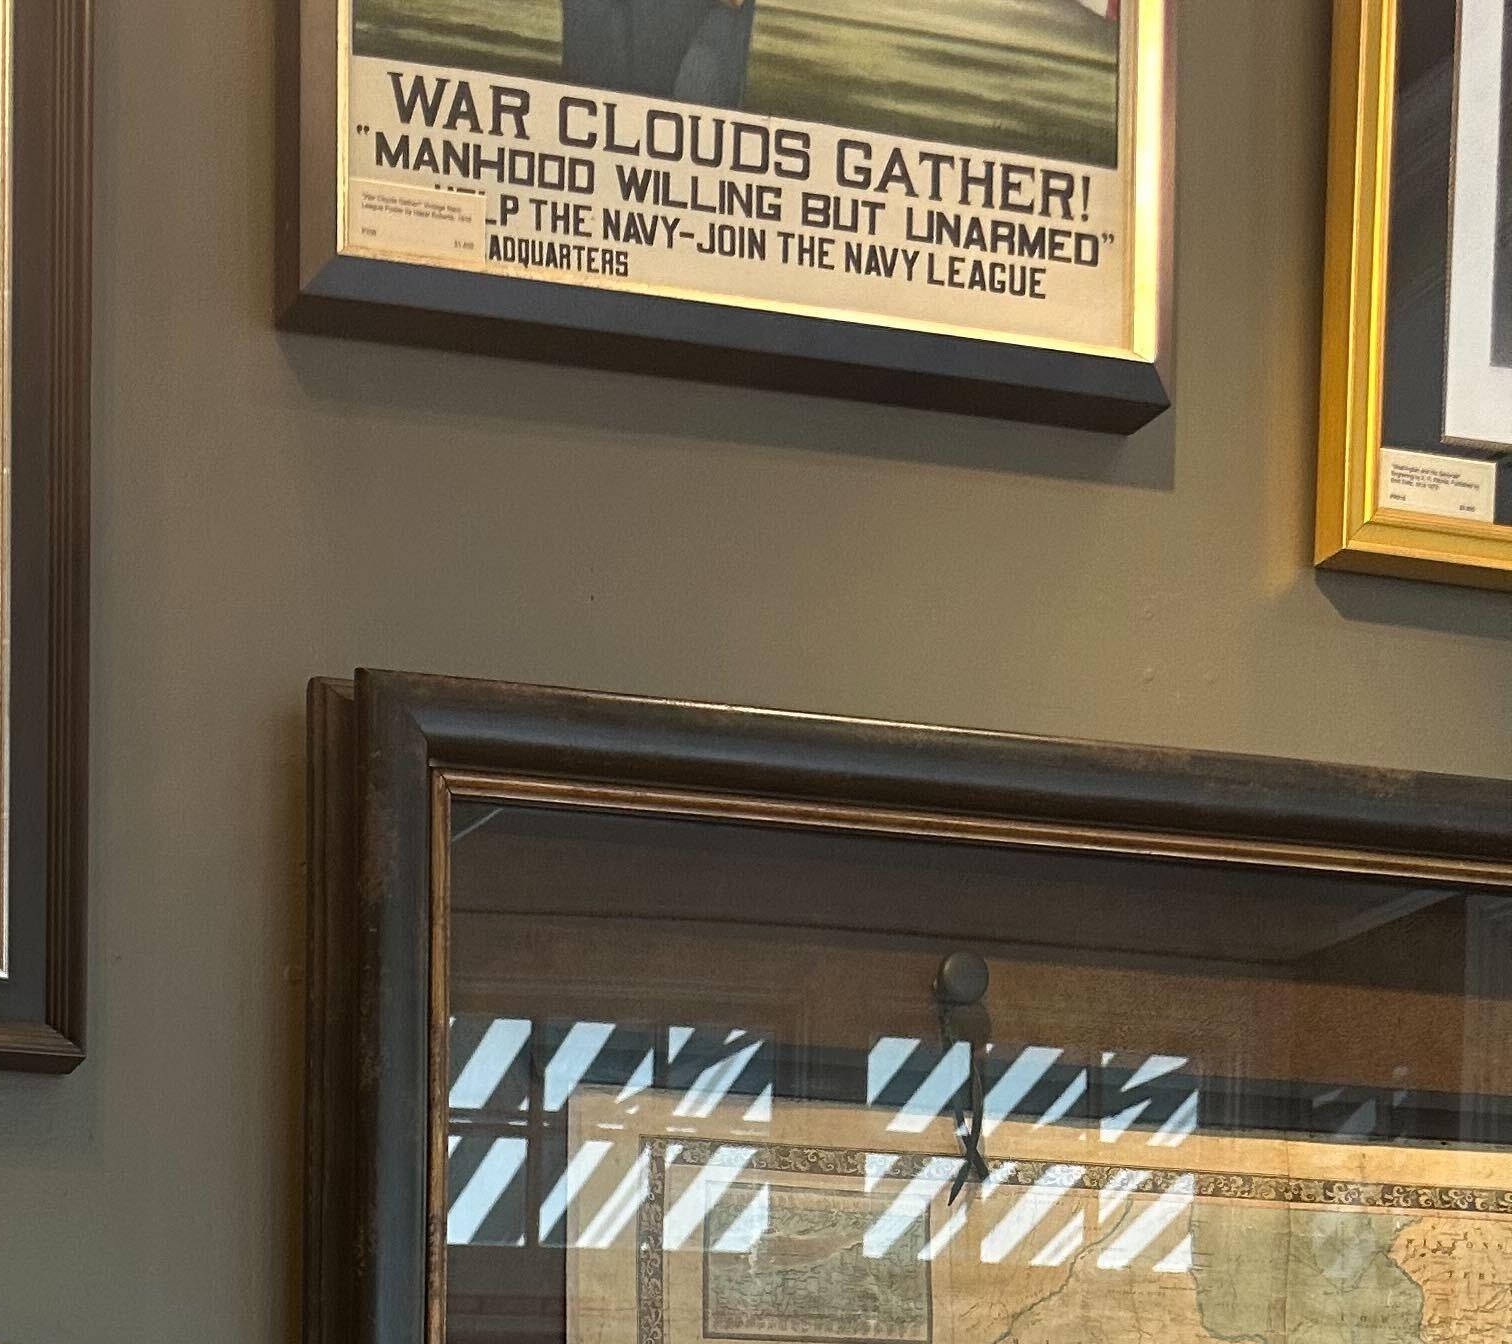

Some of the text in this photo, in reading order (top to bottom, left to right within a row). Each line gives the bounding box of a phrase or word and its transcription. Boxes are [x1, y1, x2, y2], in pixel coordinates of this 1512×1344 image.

[387, 71, 1091, 223] WAR CLOUDS GATHER!
[488, 234, 629, 277] ADQUARTERS
[529, 199, 592, 238] THE
[776, 231, 835, 270] THE
[844, 241, 920, 281] NAVY
[927, 252, 1047, 299] LEAGUE
[616, 165, 782, 222] WILLING
[801, 191, 885, 235] BUT
[906, 207, 1115, 267] UNARMED"
